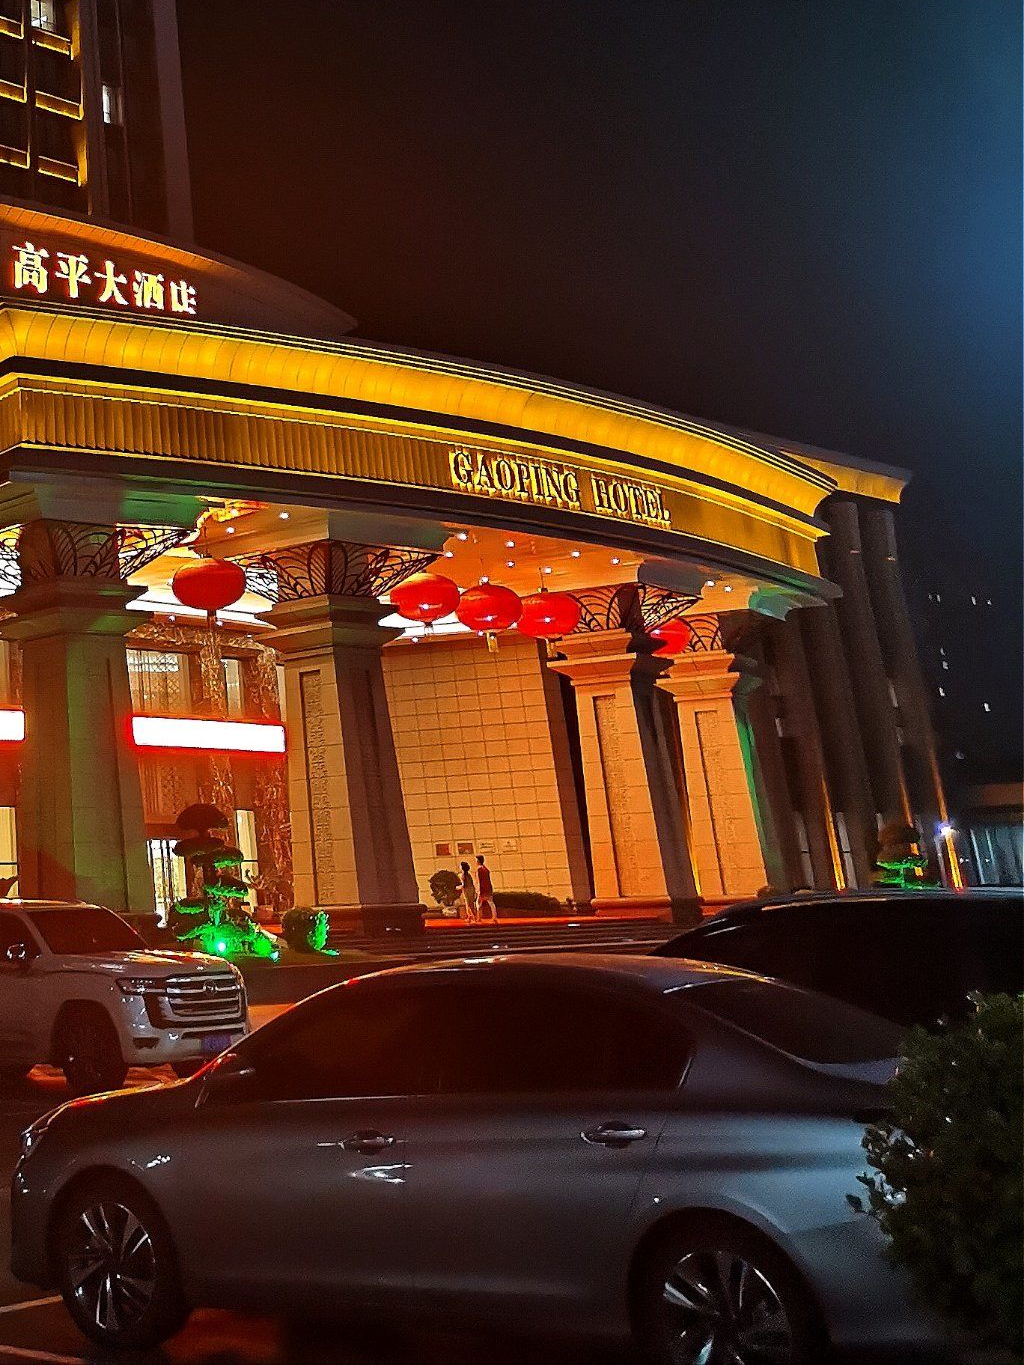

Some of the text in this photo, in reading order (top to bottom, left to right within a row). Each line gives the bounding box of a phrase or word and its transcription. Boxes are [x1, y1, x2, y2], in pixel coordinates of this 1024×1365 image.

[12, 241, 197, 315] 高平大酒店
[449, 448, 672, 526] GAOPING HOTEL
